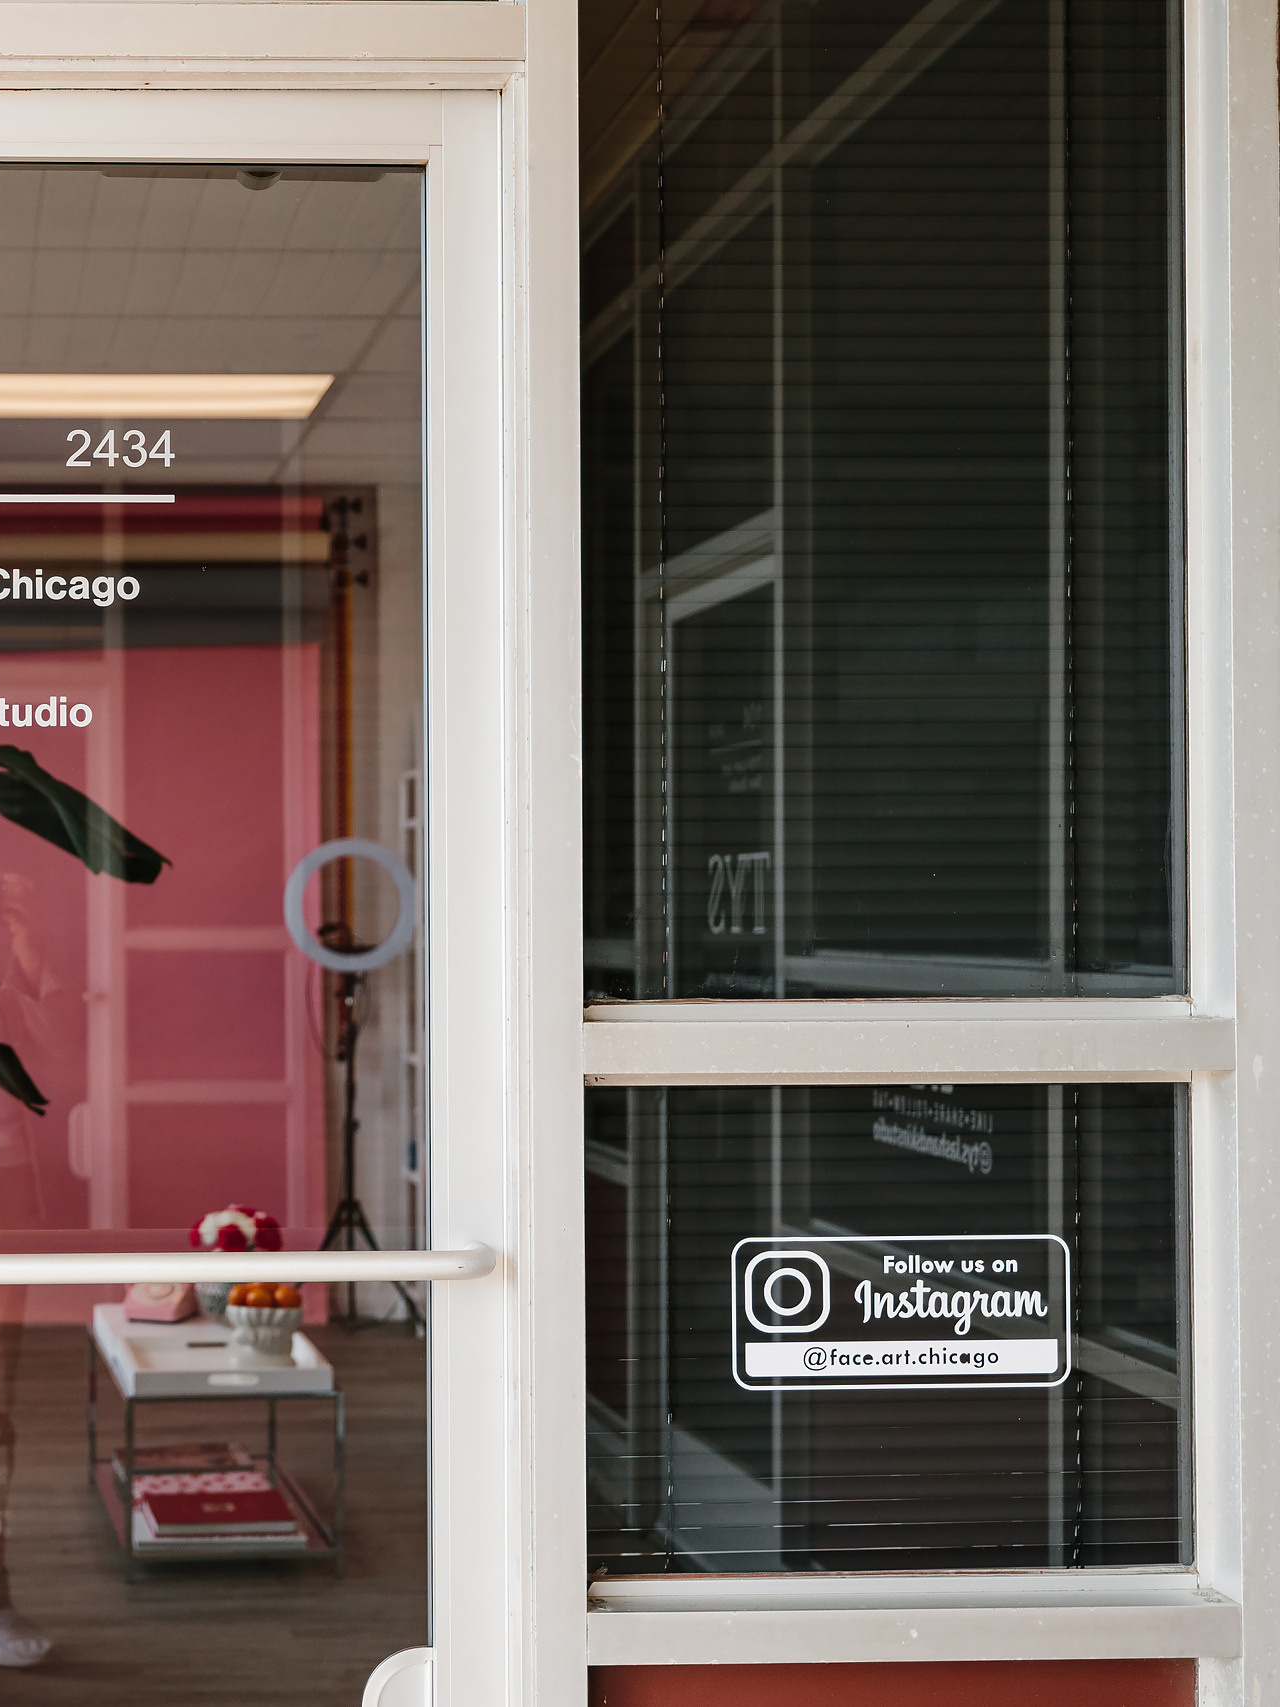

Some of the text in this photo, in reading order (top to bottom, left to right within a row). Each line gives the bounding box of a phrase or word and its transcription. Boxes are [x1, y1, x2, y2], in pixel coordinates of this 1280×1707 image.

[66, 430, 175, 467] 2434
[884, 1255, 1017, 1273] Follow us on
[855, 1280, 1047, 1335] Instagram
[803, 1346, 999, 1372] @face.art.chicago
